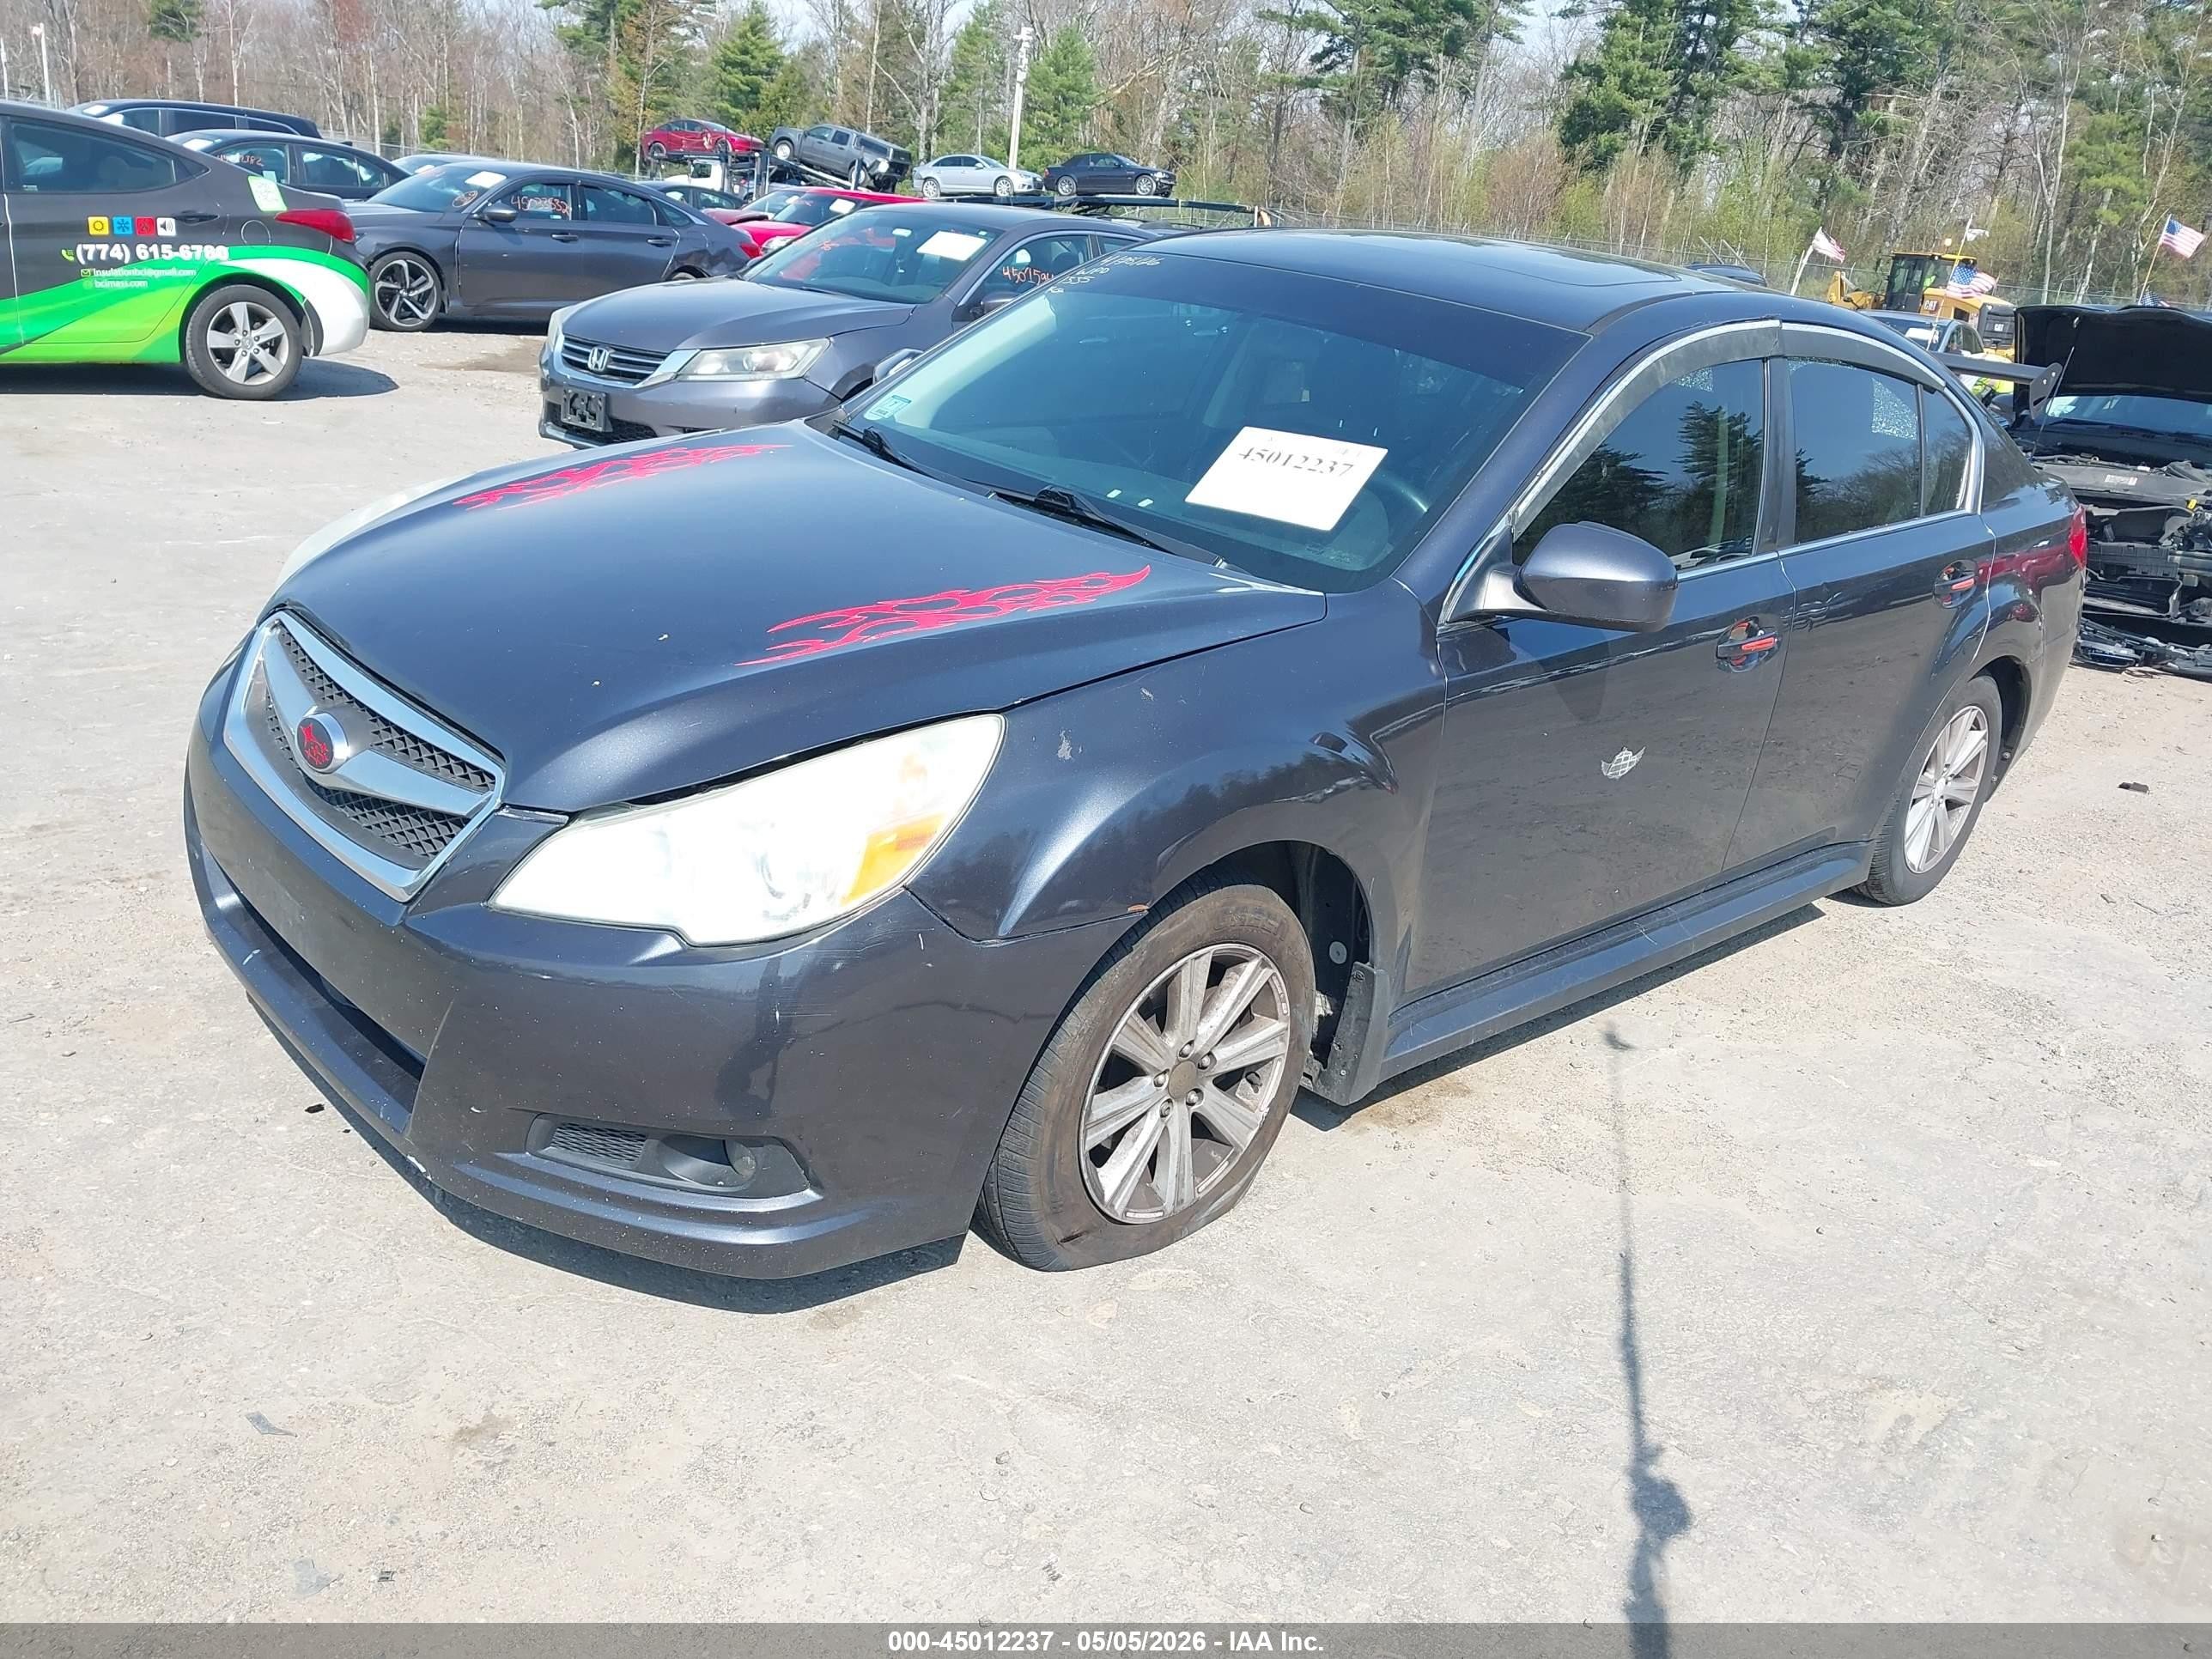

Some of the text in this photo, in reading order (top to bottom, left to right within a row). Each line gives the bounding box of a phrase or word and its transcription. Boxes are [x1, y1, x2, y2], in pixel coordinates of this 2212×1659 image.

[76, 243, 131, 264] (774)
[1924, 300, 1938, 310] CAT
[1238, 447, 1353, 476] 45012237
